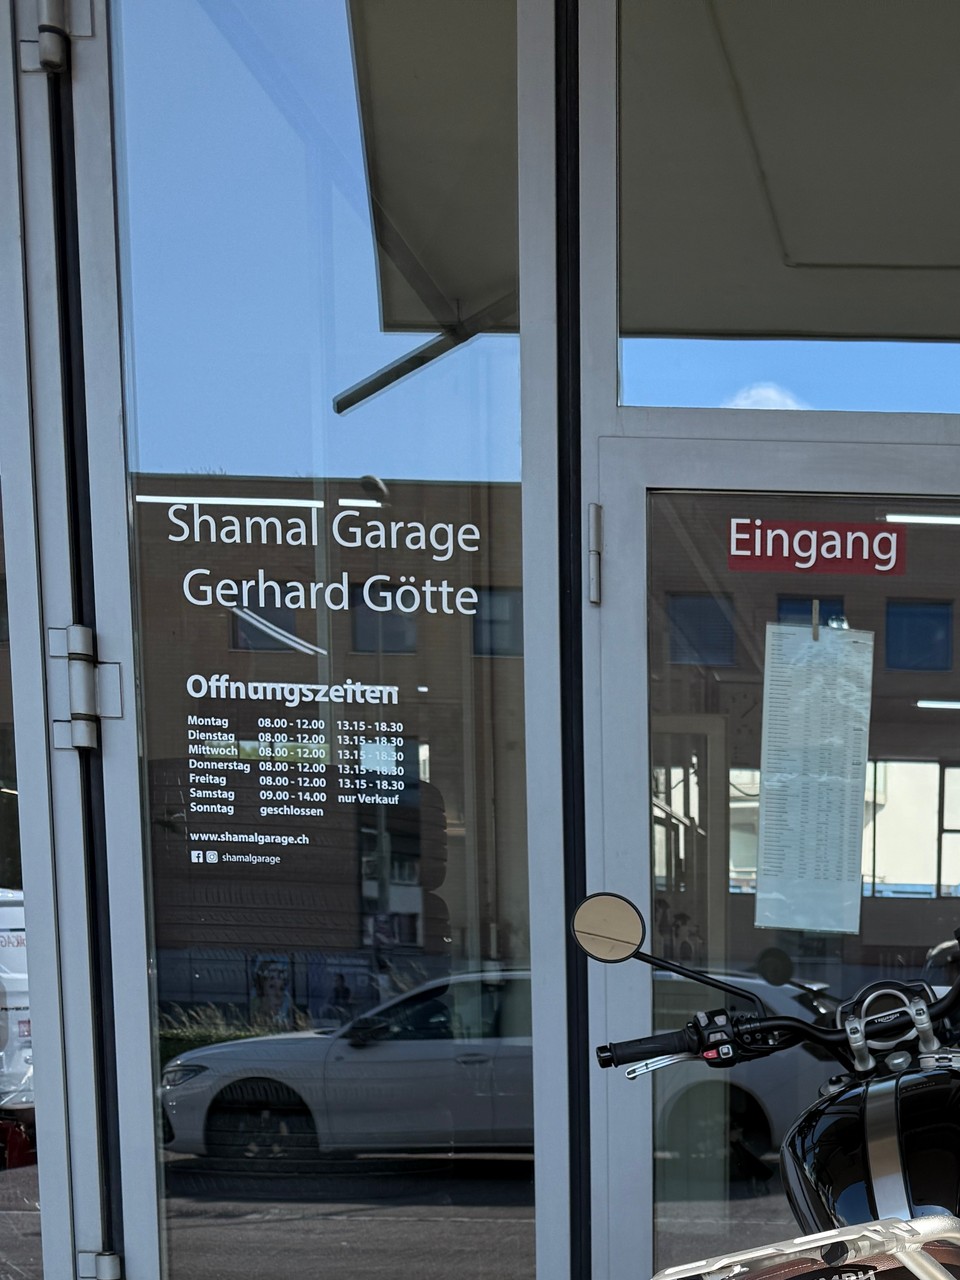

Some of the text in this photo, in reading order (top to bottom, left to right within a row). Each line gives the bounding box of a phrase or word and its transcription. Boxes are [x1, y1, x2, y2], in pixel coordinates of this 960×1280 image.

[167, 503, 481, 562] Shamal Garage
[730, 518, 897, 571] Eingang
[182, 568, 479, 615] Gerhard Götte
[187, 715, 229, 728] Montag
[257, 718, 287, 729] 08.00
[295, 719, 325, 730] 12.00
[337, 721, 365, 731] 13.15
[374, 722, 403, 732] 18.30
[188, 730, 235, 742] Dienstag
[258, 733, 288, 743] 08.00
[296, 734, 325, 744] 12.00
[337, 736, 365, 746] 13.15
[374, 737, 403, 747] 18.30
[188, 745, 238, 756] Mittwoch
[258, 747, 288, 758] 08.00
[296, 748, 326, 759] 12.00
[189, 759, 250, 773] Donnerstag
[259, 762, 288, 772] 08.00
[297, 763, 326, 773] 12.00
[189, 774, 226, 786] Freitag
[259, 776, 289, 787] 08.00
[297, 777, 326, 788] 12.00
[338, 779, 366, 789] 13.15
[376, 780, 404, 791] 18.30
[189, 788, 235, 801] Samstag
[259, 790, 289, 801] 09.00
[297, 791, 327, 802] 14.00
[338, 795, 356, 804] nur
[358, 794, 400, 805] Verkauf
[190, 803, 324, 816] Sonntag geschlossen
[190, 831, 310, 845] www.shamalgarage.ch
[222, 853, 281, 864] shamalgarage
